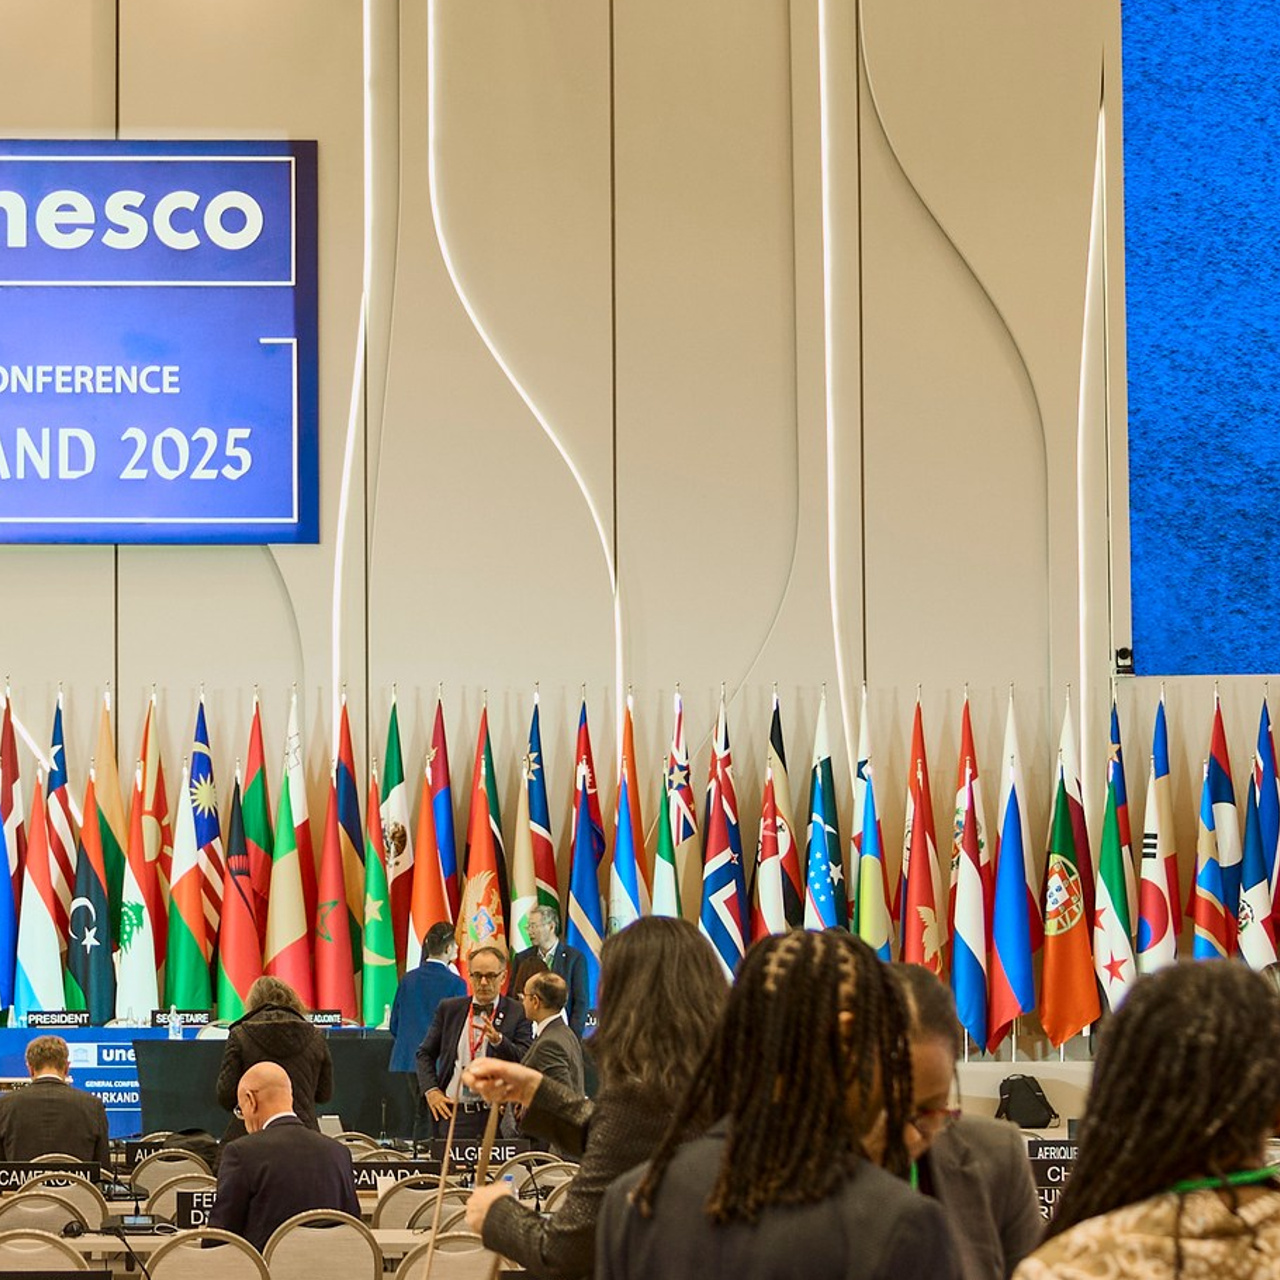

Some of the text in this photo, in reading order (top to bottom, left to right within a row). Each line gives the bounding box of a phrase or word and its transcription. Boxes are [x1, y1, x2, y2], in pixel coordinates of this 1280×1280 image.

[119, 426, 253, 481] 2025
[28, 1013, 90, 1024] PRESIDENT
[156, 1013, 209, 1023] SECETAIRE
[85, 1080, 113, 1088] GENERAL
